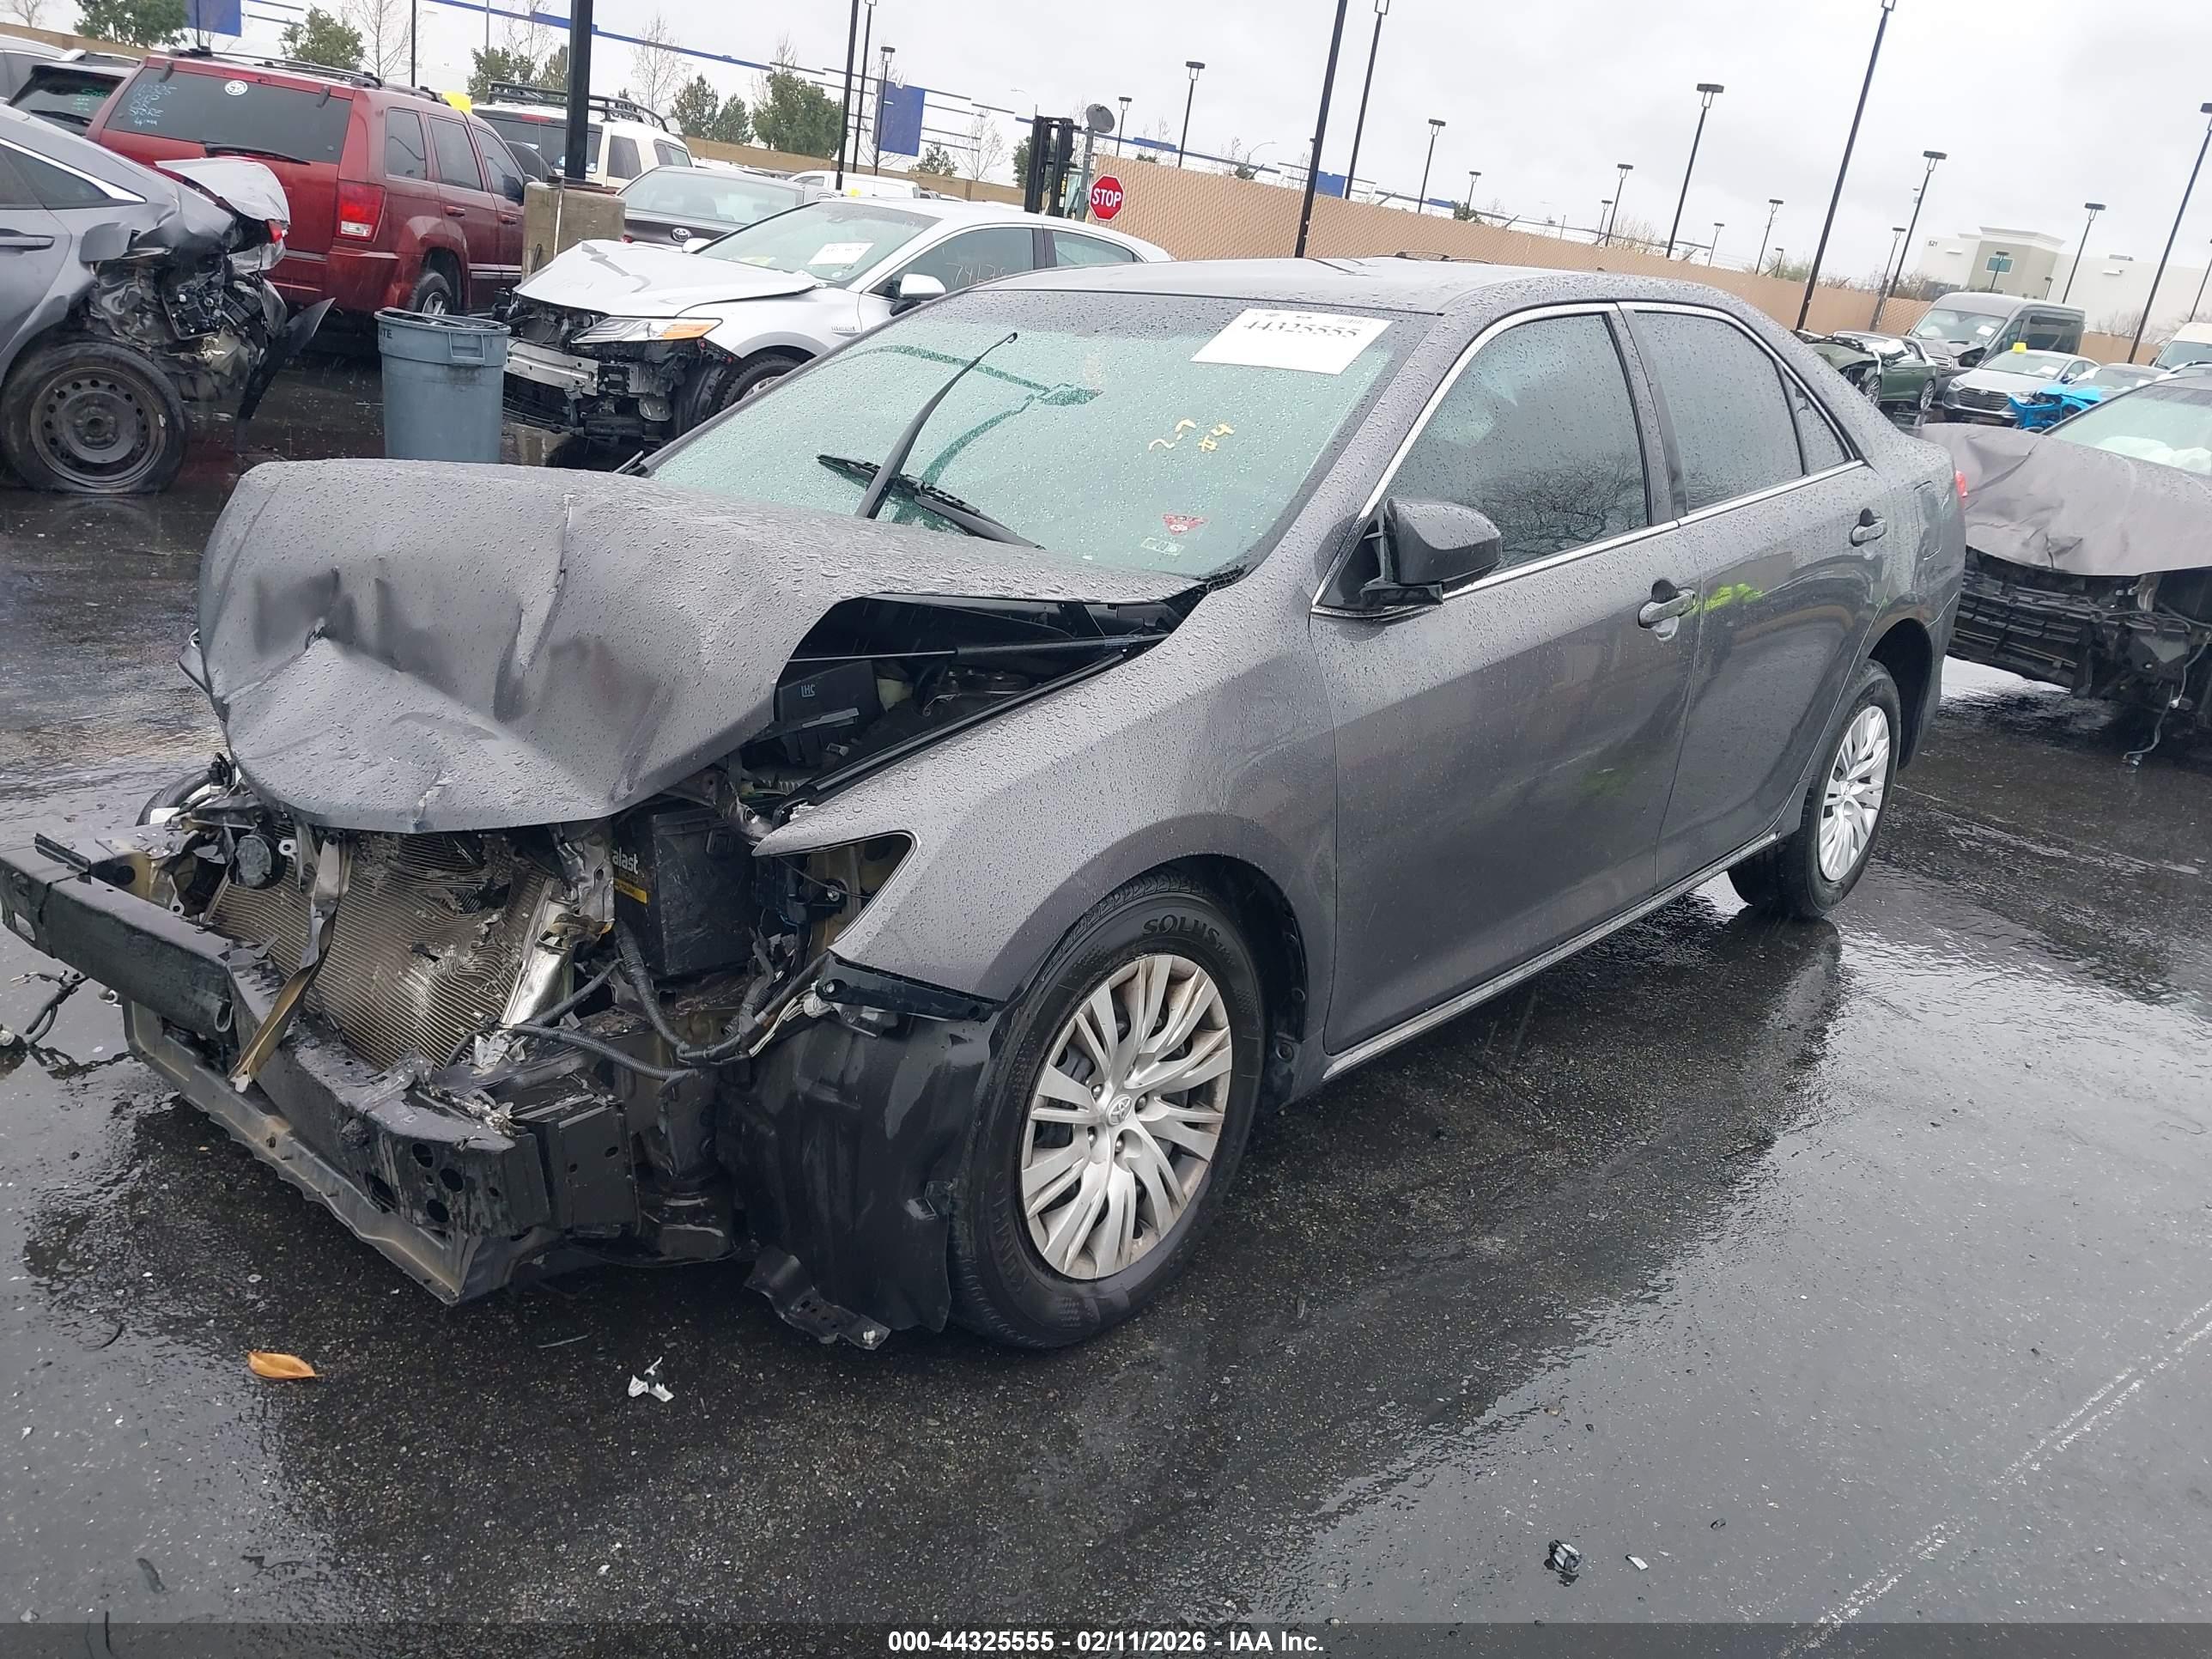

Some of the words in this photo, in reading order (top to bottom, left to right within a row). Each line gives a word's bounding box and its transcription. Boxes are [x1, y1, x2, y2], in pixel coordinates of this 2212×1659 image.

[1091, 188, 1121, 208] STOP
[1243, 321, 1361, 337] 44325555
[612, 847, 639, 875] alast
[1143, 914, 1220, 944] SOLUS
